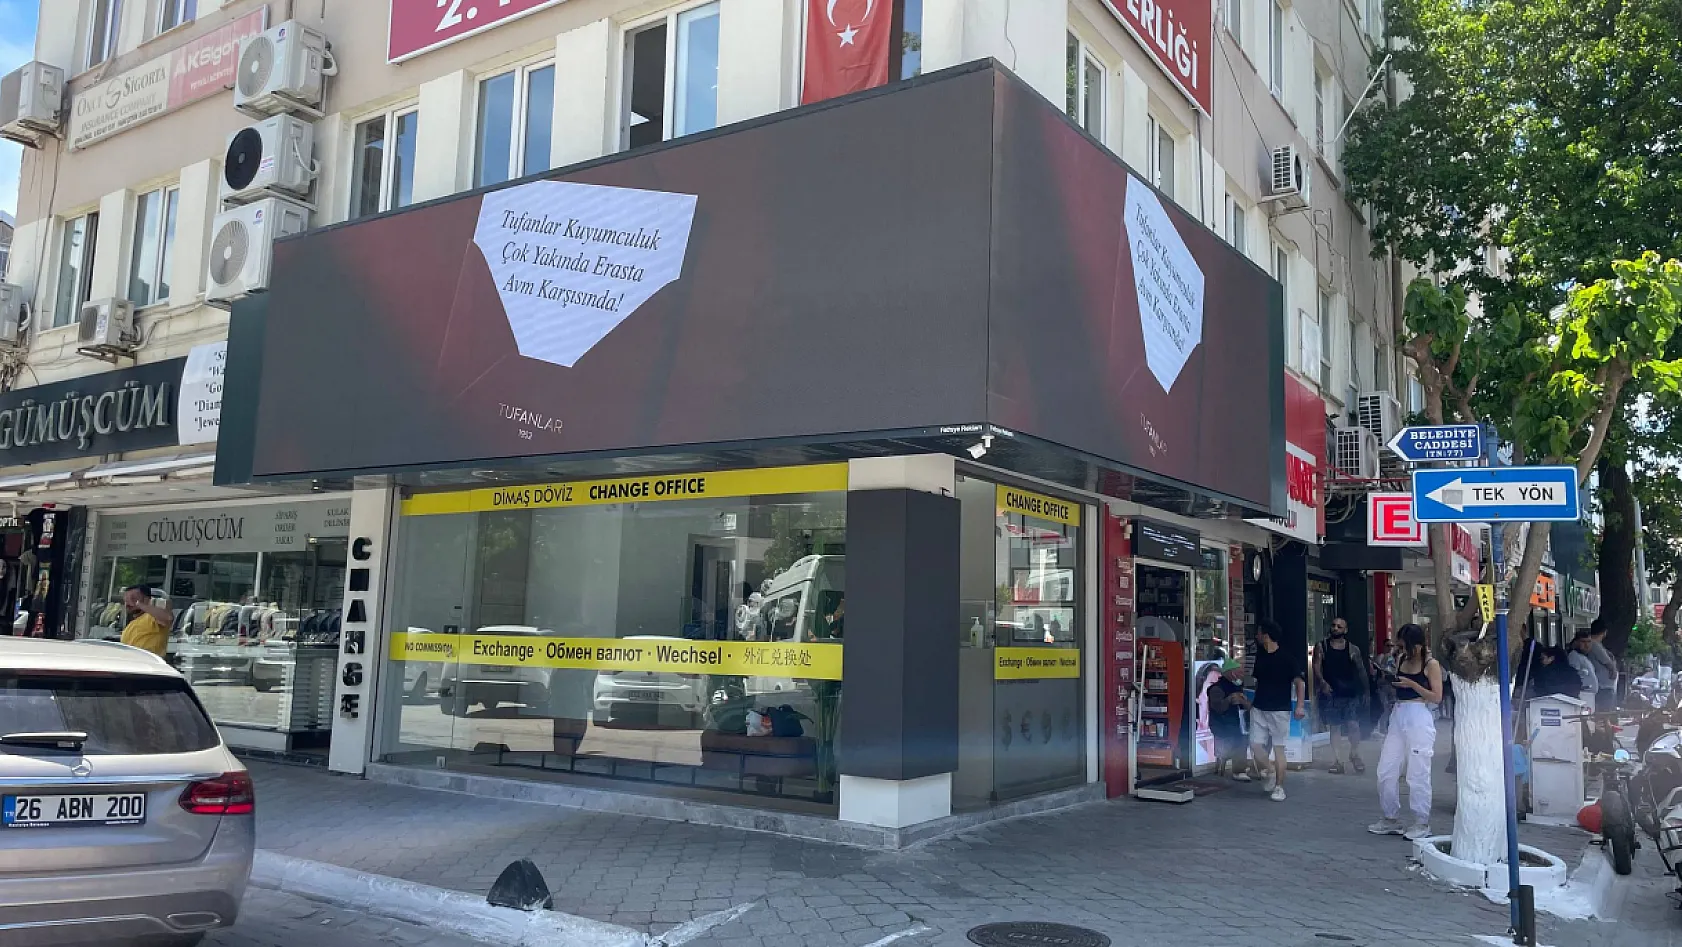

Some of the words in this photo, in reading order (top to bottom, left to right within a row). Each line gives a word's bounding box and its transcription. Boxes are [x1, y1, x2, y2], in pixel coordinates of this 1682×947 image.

[501, 209, 562, 236] Tufanlar
[562, 218, 662, 250] Kuyumculuk
[502, 241, 530, 264] Çok
[532, 245, 590, 273] Yakında
[592, 255, 645, 282] Erasta
[503, 273, 534, 295] Avm
[538, 279, 624, 312] Karşısında!
[0, 380, 170, 450] GÜMÜŞCÜM
[499, 403, 563, 434] TUFANLAR
[1410, 429, 1476, 440] BELEDİYE
[1414, 440, 1473, 450] CADDESİ
[493, 488, 530, 507] DİMAŞ
[534, 484, 573, 503] DÖVİZ
[589, 481, 650, 500] CHANGE
[654, 478, 705, 496] OFFICE
[1006, 491, 1042, 514] CHANGE
[1043, 502, 1069, 520] OFFICE
[1472, 488, 1505, 501] TEK
[1519, 484, 1553, 501] YÖN
[147, 513, 245, 548] GÜMÜŞCÜM
[1383, 503, 1411, 535] E
[340, 536, 373, 719] CHANGE
[474, 640, 534, 661] Exchange
[656, 646, 722, 665] Wechsel
[742, 647, 812, 667] 外汇兑换处
[17, 798, 42, 820] 26
[56, 797, 94, 819] ABN
[106, 796, 142, 818] 200
